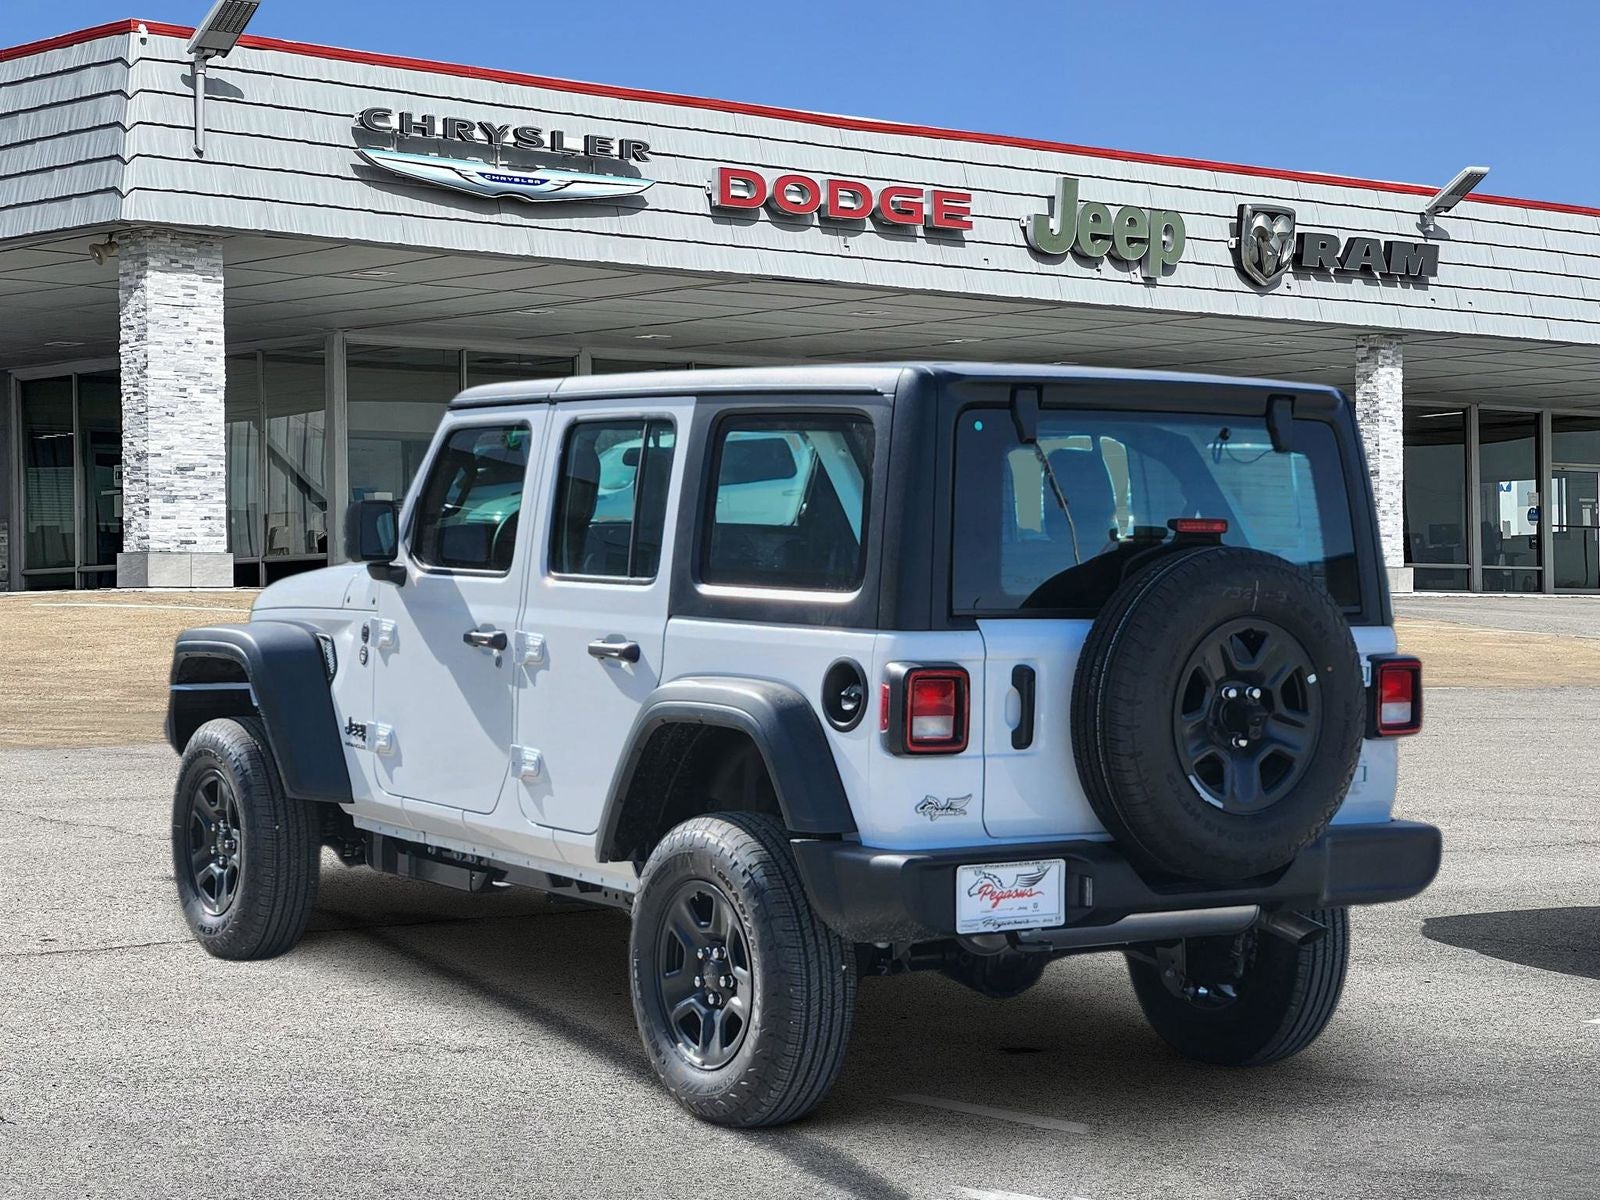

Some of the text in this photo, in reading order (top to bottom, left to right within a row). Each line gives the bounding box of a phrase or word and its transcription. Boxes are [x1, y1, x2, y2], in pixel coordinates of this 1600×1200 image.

[357, 106, 651, 162] CHRYSLER
[484, 173, 542, 185] CHRYSLER
[712, 166, 974, 231] DODGE
[1026, 176, 1186, 278] Jeep
[1296, 232, 1440, 278] RAM
[978, 884, 1045, 909] Pegasus
